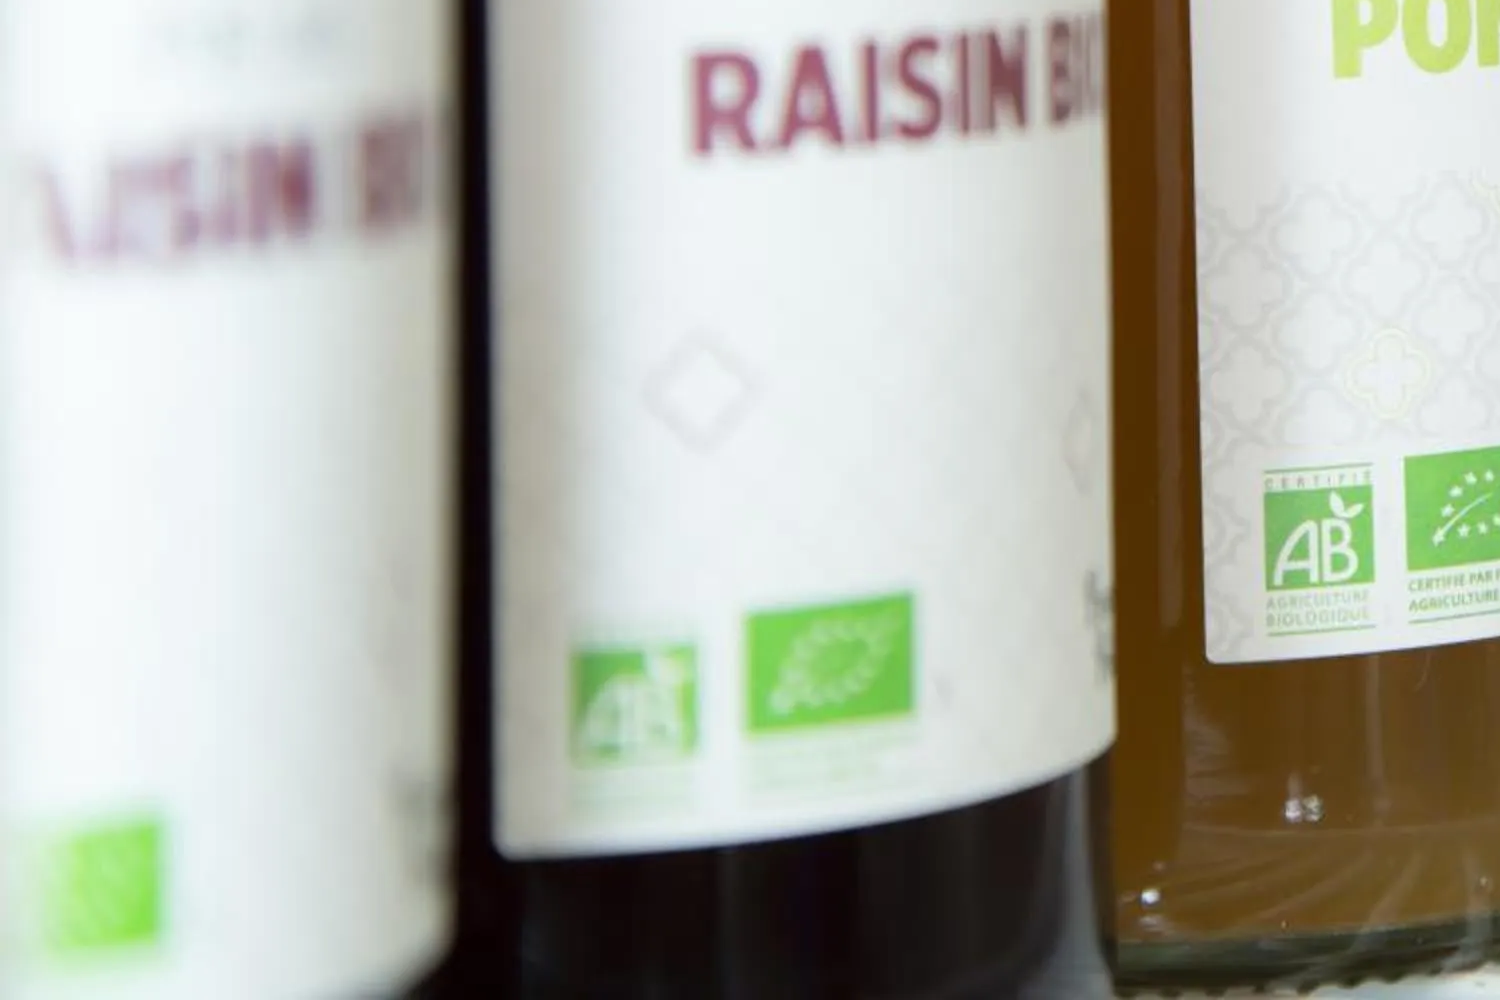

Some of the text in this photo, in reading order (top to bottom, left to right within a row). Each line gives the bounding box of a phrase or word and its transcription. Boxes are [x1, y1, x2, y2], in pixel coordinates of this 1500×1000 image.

[688, 18, 1029, 158] RAISIN
[1273, 518, 1360, 587] AB
[1408, 588, 1500, 613] AGRICULTURE
